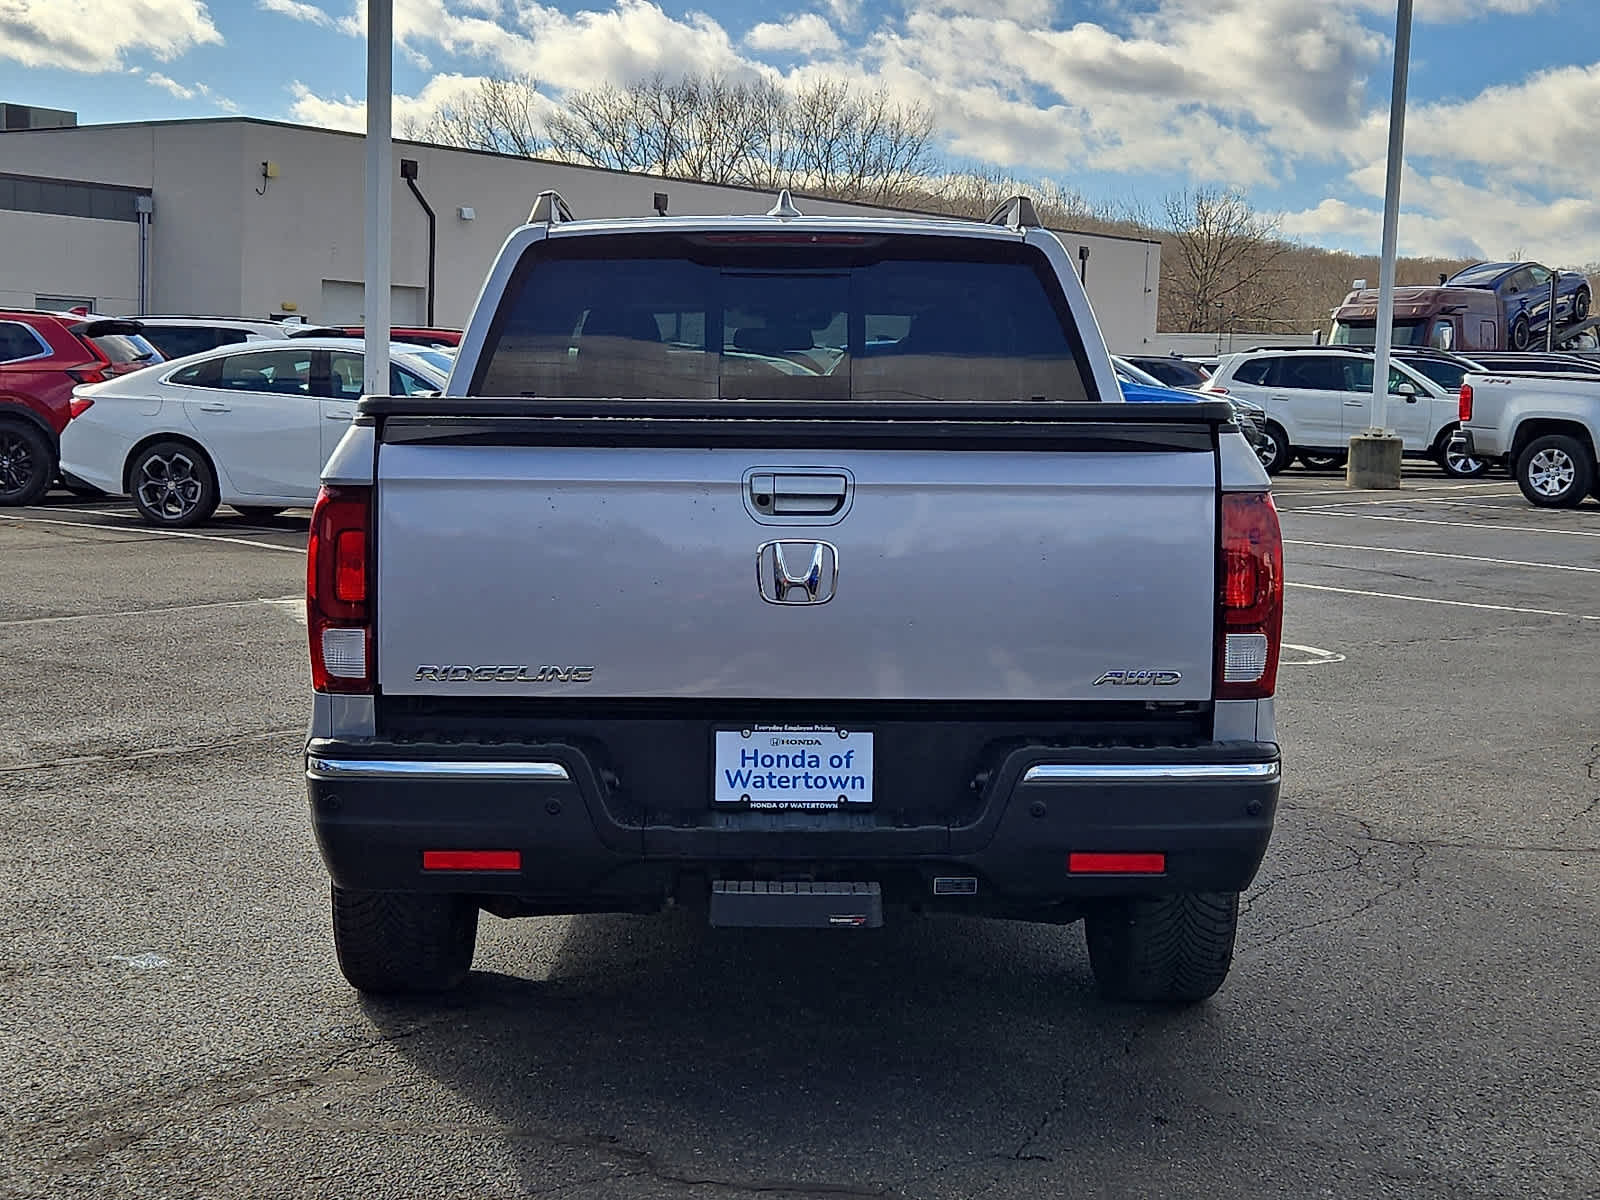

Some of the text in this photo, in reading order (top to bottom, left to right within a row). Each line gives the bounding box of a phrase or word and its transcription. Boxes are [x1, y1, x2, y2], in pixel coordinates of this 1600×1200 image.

[414, 664, 595, 683] RIDGELINE
[1092, 669, 1183, 686] AWD
[741, 748, 855, 769] Honda of
[725, 769, 865, 790] Watertown
